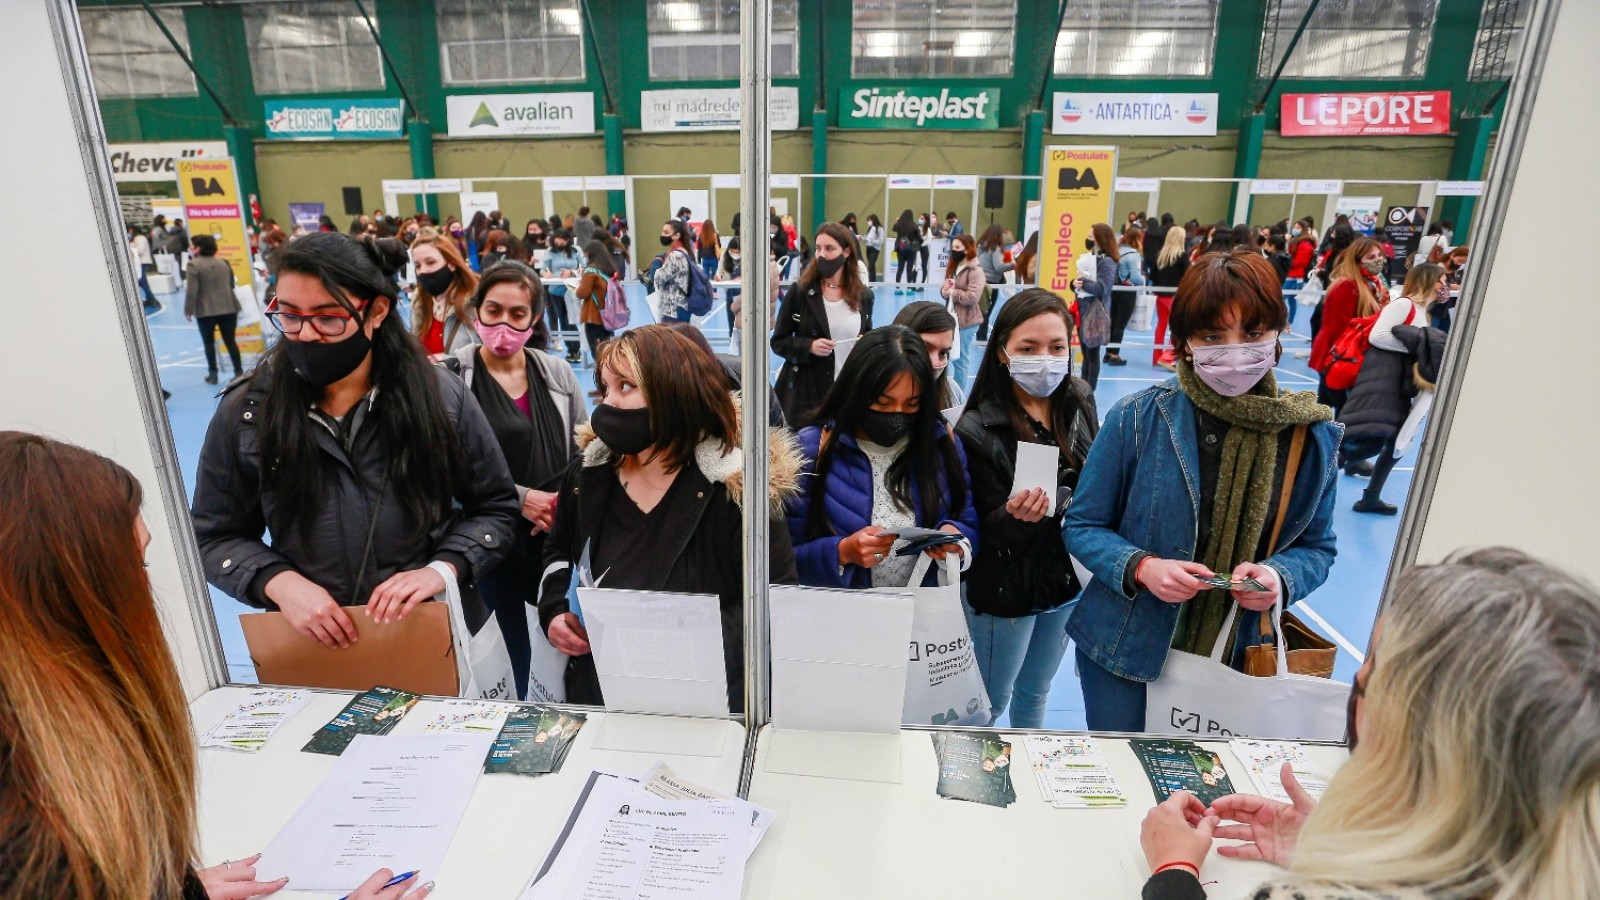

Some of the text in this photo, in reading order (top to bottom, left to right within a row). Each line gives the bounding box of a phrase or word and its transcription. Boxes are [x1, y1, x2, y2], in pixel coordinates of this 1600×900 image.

[504, 102, 573, 121] avalian
[676, 97, 740, 112] madrede
[851, 88, 989, 126] Sinteplast
[1096, 103, 1172, 120] ANTARTICA
[1297, 95, 1435, 126] LEPORE
[288, 110, 332, 129] ECOSAN
[355, 110, 399, 129] ECOSAN
[1067, 151, 1109, 160] Postulate
[191, 177, 225, 197] BA
[1058, 167, 1100, 190] BA
[1051, 212, 1073, 290] Empleo
